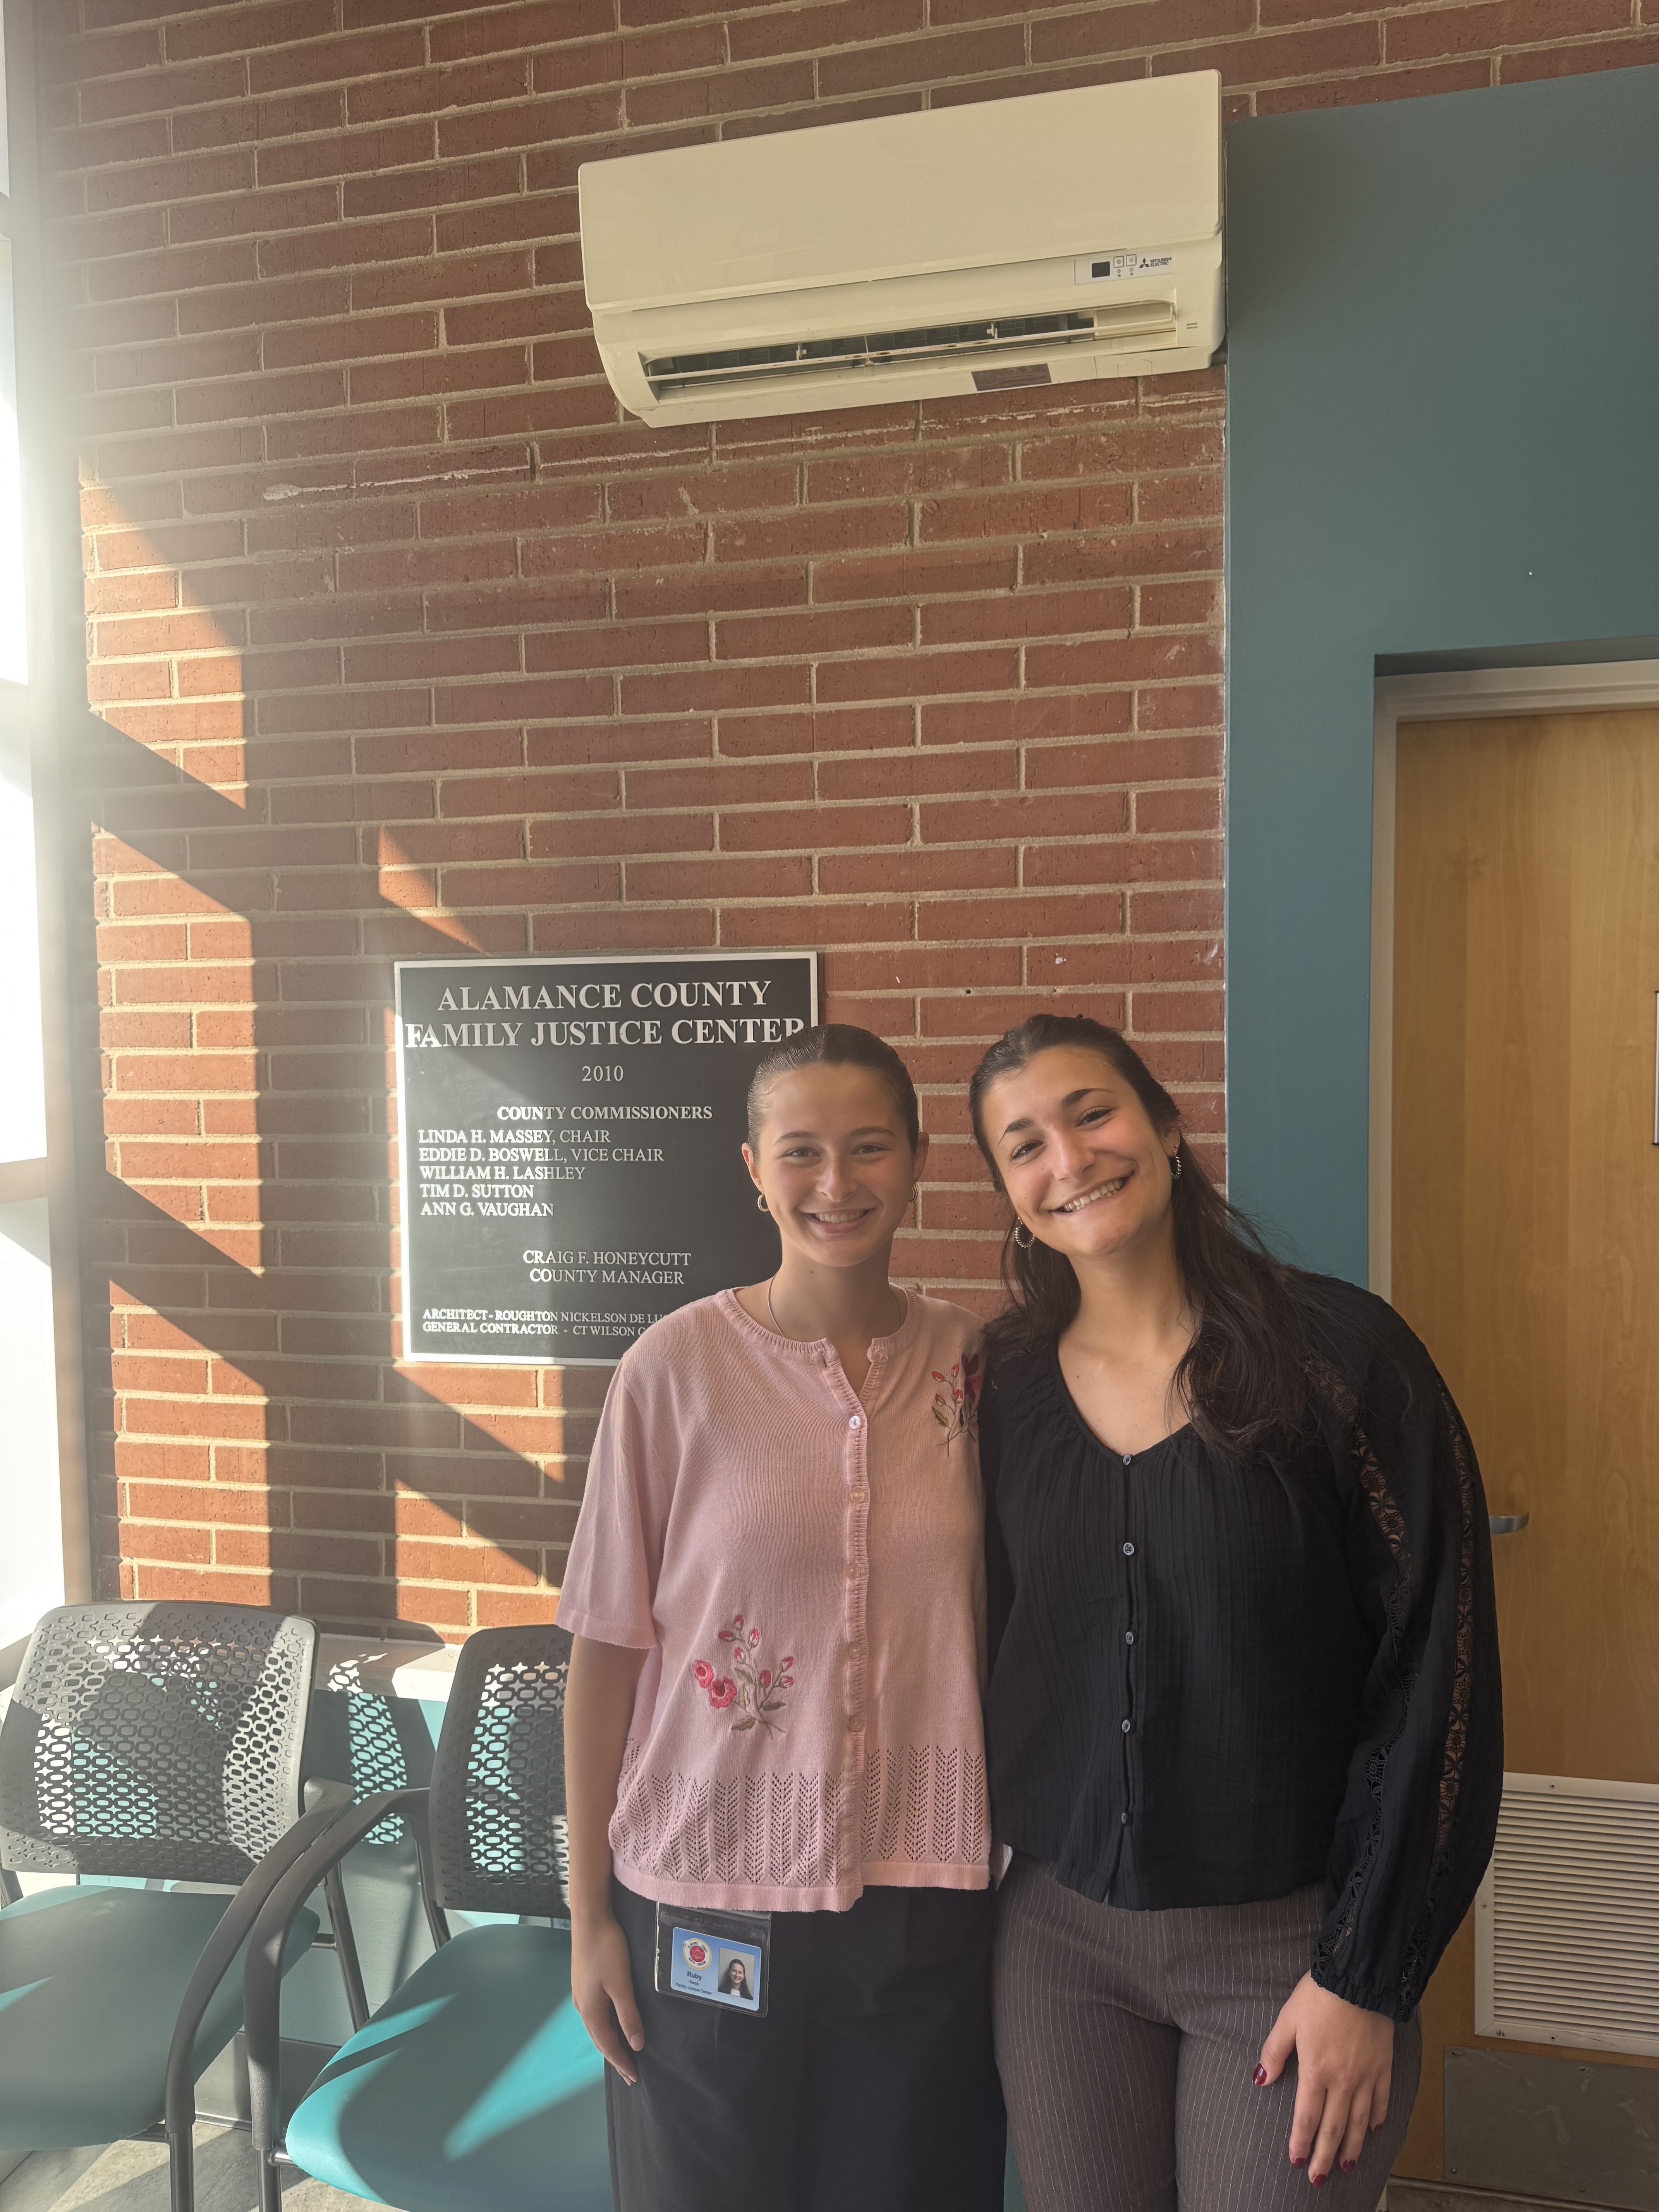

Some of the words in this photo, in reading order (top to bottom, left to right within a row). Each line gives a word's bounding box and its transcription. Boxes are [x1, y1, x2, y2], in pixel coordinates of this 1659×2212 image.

[437, 984, 621, 1010] ALAMANCE
[631, 981, 771, 1007] COUNTY
[405, 1022, 523, 1048] FAMILY
[531, 1020, 662, 1046] JUSTICE
[672, 1018, 804, 1044] CENTER
[582, 1065, 624, 1081] 2010
[497, 1106, 566, 1120] COUNTY
[570, 1106, 712, 1119] COMMISSIONERS
[418, 1130, 468, 1143] LINDA
[471, 1130, 486, 1143] H.
[489, 1130, 556, 1145] MASSEY,
[560, 1130, 611, 1142] CHAIR
[419, 1147, 467, 1161] EDDIE
[469, 1148, 485, 1161] D.
[488, 1148, 567, 1163] BOSWELL,
[570, 1148, 608, 1161] VICE
[613, 1148, 664, 1161] CHAIR
[420, 1166, 491, 1179] WILLIAM
[494, 1166, 509, 1179] H.
[513, 1166, 585, 1180] LASHLEY
[420, 1183, 450, 1197] TIM
[452, 1184, 468, 1197] D.
[472, 1184, 534, 1198] SUTTON
[421, 1202, 456, 1216] ANN
[460, 1202, 474, 1216] G.
[477, 1202, 554, 1216] VAUGHAN
[523, 1250, 574, 1264] CRAIG
[578, 1251, 589, 1264] F.
[593, 1252, 691, 1266] HONEYCUTT
[530, 1267, 598, 1282] COUNTY
[602, 1270, 684, 1284] MANAGER
[422, 1309, 488, 1320] ARCHITECT
[495, 1310, 558, 1321] ROUGHTON
[561, 1312, 627, 1322] NICKELSON
[629, 1313, 645, 1323] DE
[422, 1321, 478, 1333] GENERAL
[479, 1323, 559, 1334] CONTRACTOR
[573, 1325, 587, 1334] CT
[590, 1325, 635, 1336] WILSON
[687, 1971, 702, 1981] Ruby
